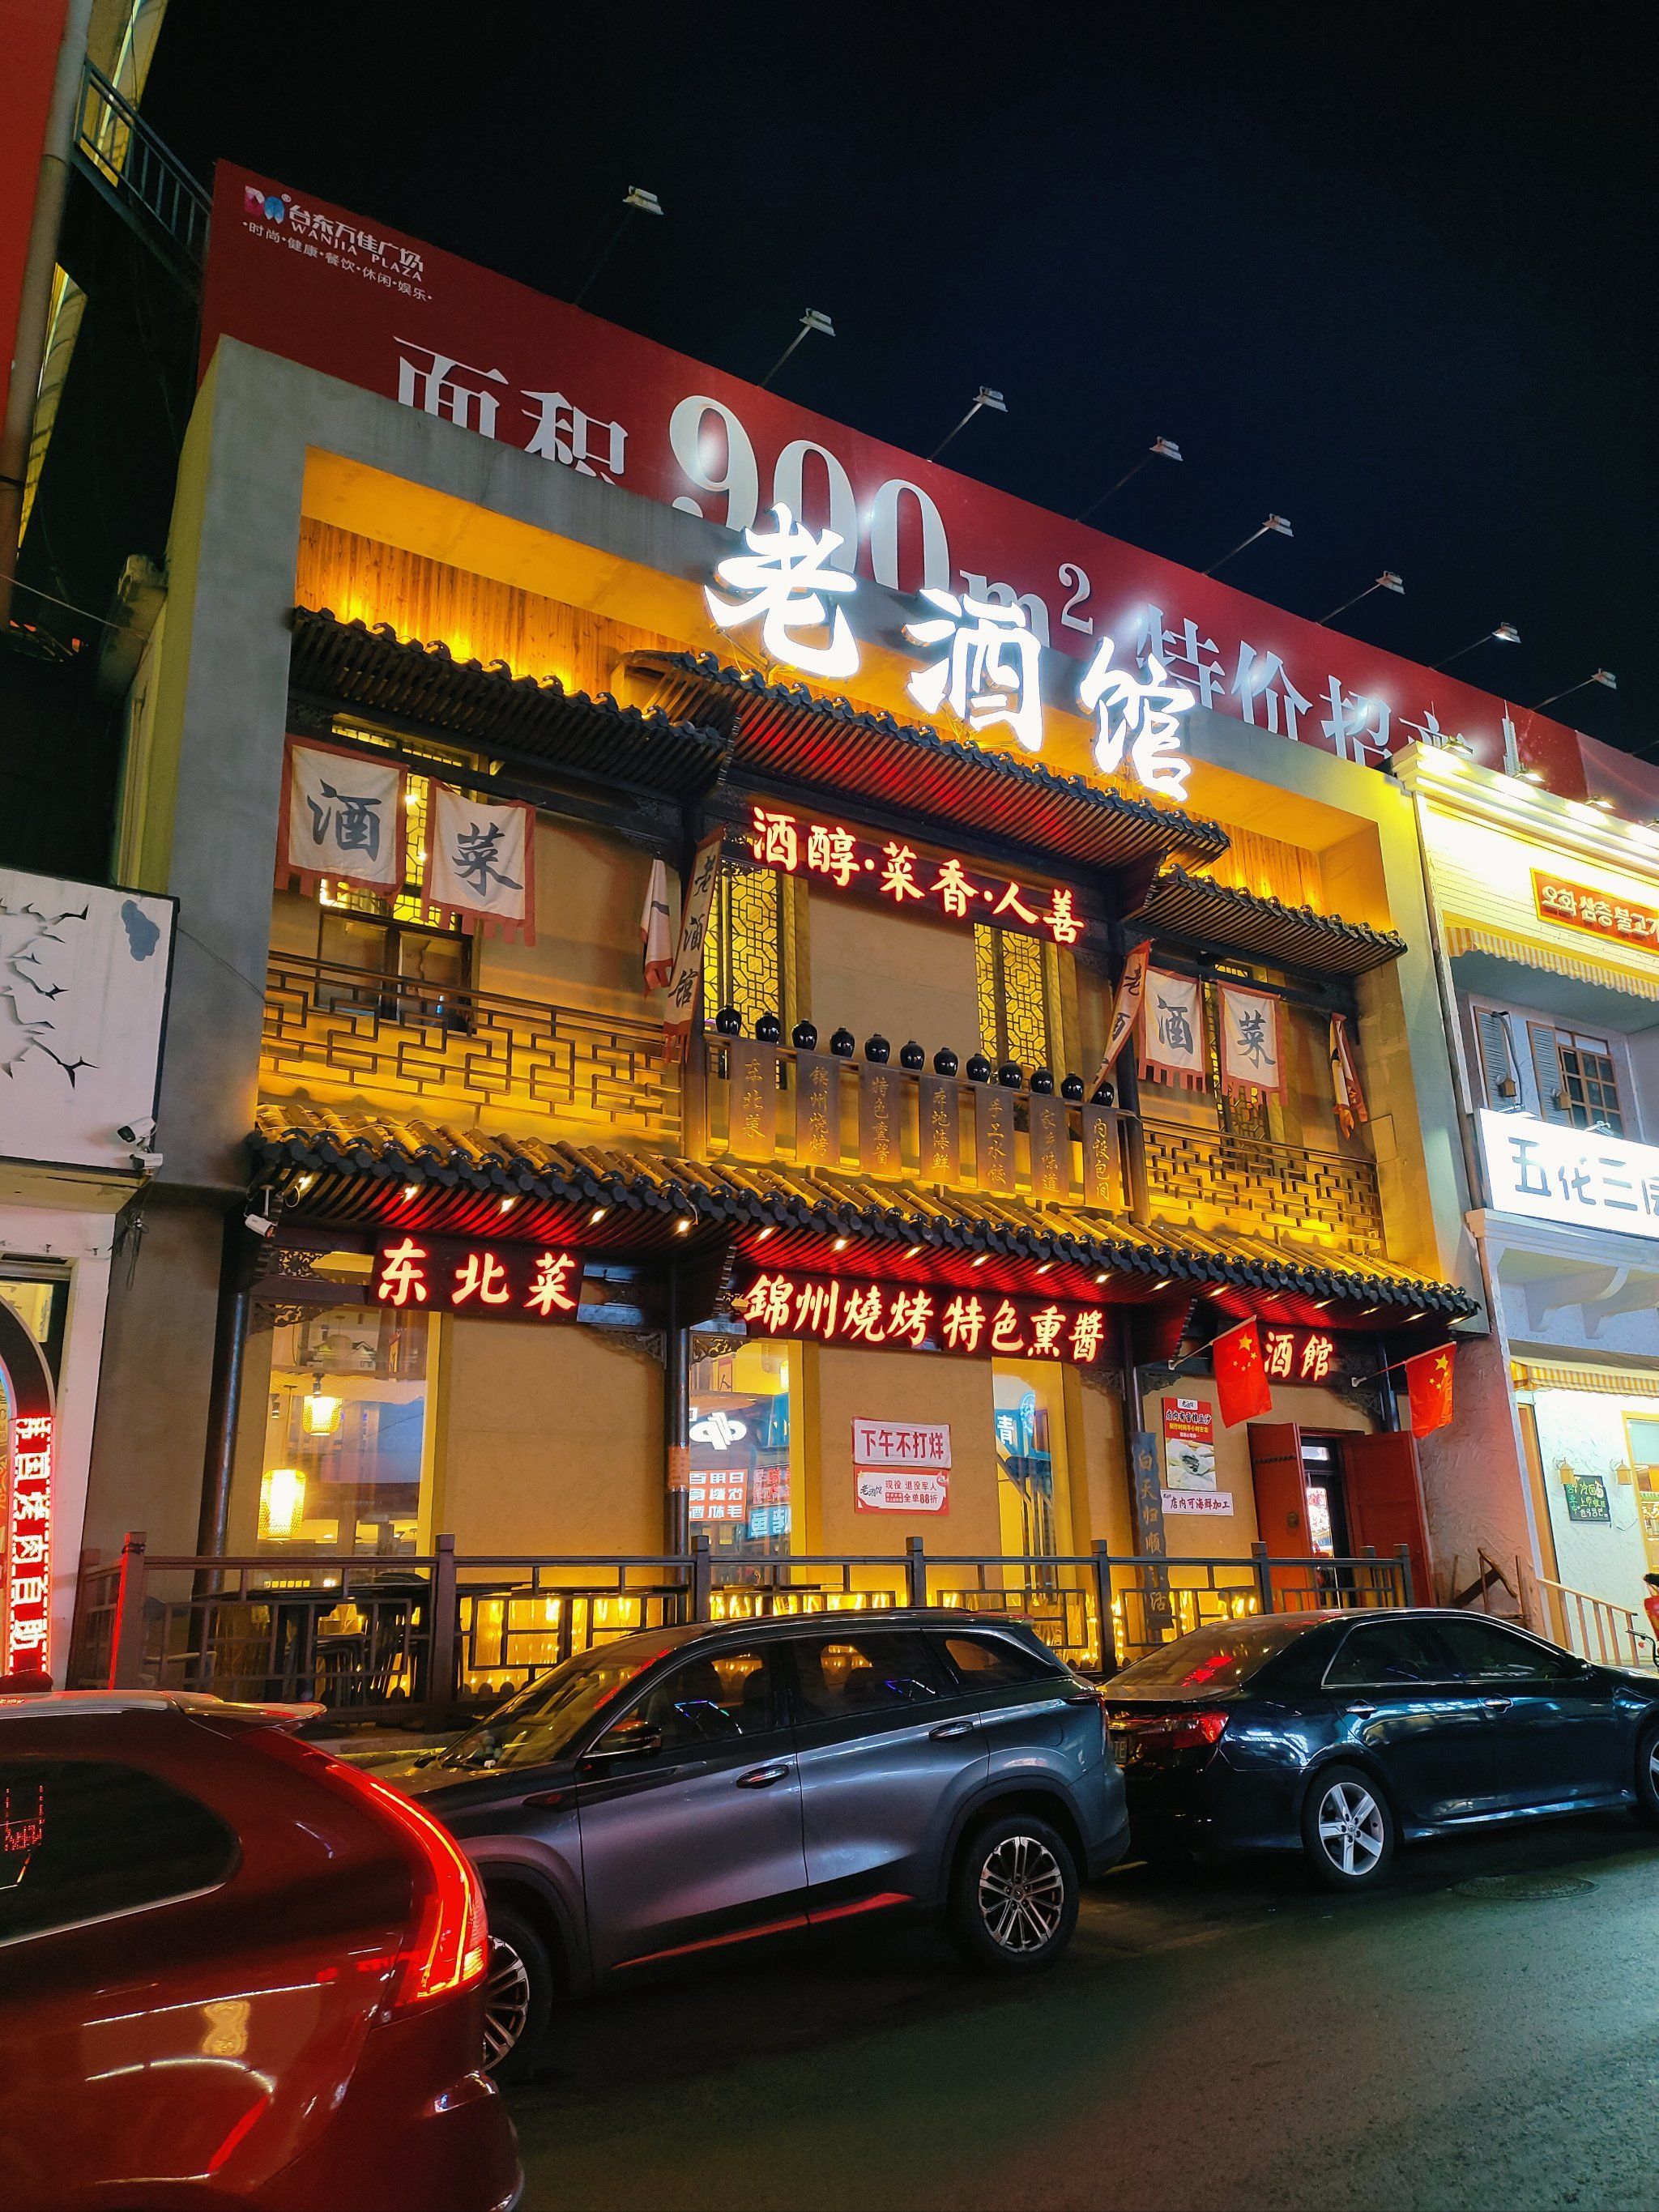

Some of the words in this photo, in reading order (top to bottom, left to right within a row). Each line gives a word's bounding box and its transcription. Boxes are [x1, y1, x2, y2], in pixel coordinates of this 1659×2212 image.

[291, 221, 358, 256] WANJIA
[371, 254, 423, 283] PLAZA
[704, 501, 1196, 802] 老酒馆
[1136, 603, 1469, 766] 特价招
[306, 778, 383, 862] 酒
[452, 821, 524, 897] 菜
[1542, 885, 1577, 916] 오화
[1579, 895, 1614, 927] 삼층
[1157, 995, 1194, 1055] 酒
[1237, 1009, 1277, 1069] 菜
[377, 1238, 577, 1316] 东北菜
[1264, 1331, 1333, 1383] 酒館
[860, 1429, 944, 1460] 下午不打烊
